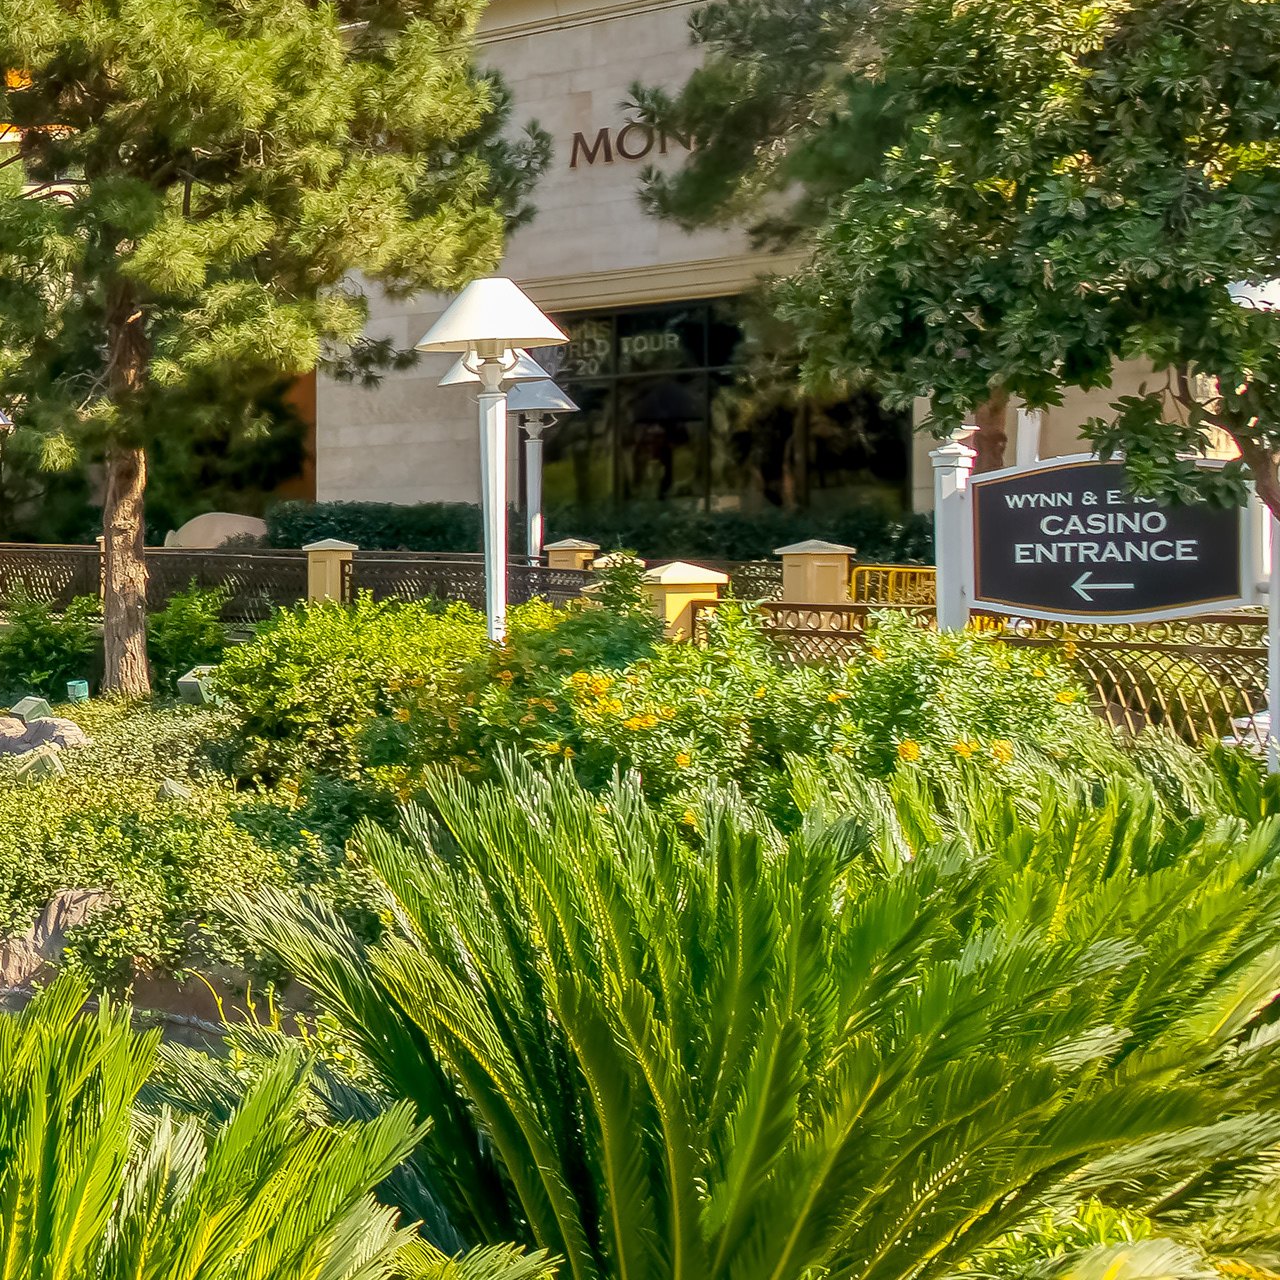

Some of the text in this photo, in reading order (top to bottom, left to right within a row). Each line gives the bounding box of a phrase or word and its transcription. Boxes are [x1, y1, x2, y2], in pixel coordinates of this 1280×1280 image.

[620, 332, 681, 355] TOUR
[1004, 491, 1073, 510] WYNN
[1080, 490, 1099, 506] &
[1039, 511, 1168, 536] CASINO
[1013, 539, 1199, 564] ENTRANCE
